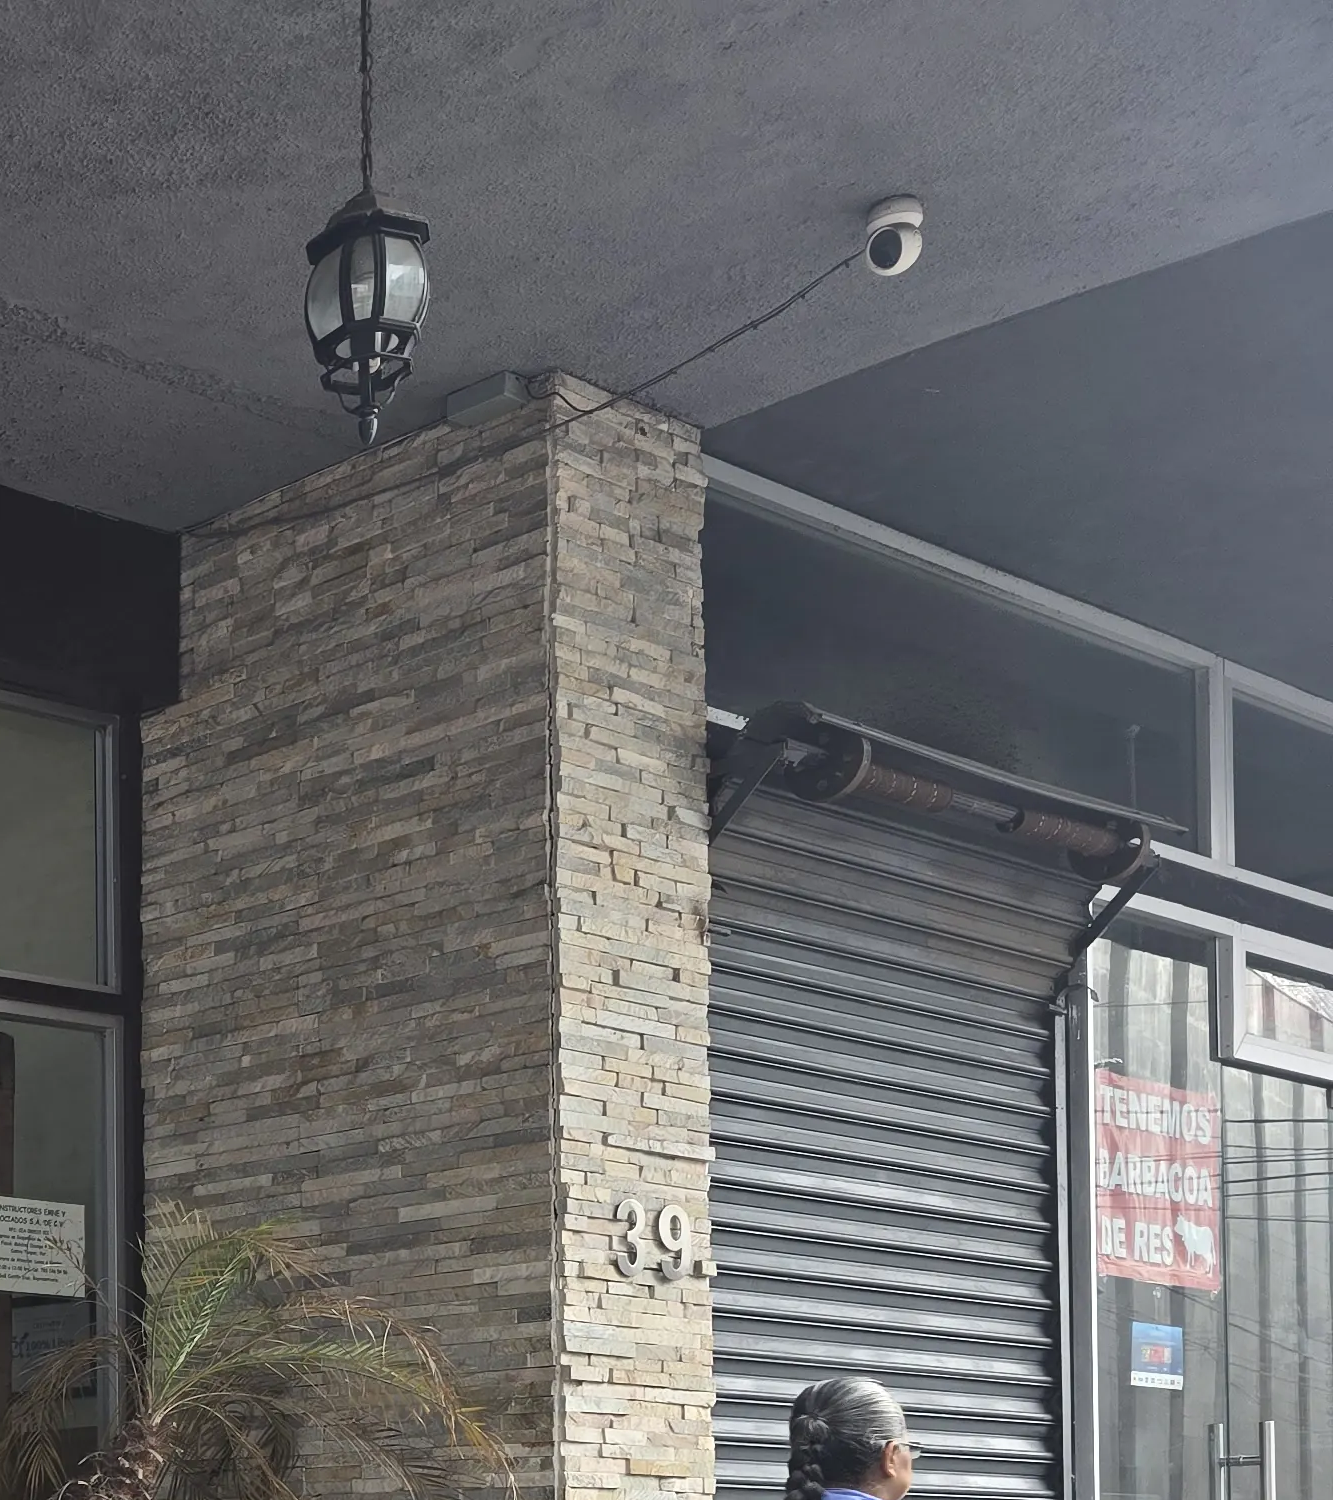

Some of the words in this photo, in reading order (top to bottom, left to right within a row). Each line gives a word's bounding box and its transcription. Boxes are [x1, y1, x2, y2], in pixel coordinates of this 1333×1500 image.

[1099, 1084, 1213, 1145] TENEMOS
[1098, 1148, 1213, 1208] BARBACOA
[616, 1198, 692, 1282] 39
[1101, 1215, 1127, 1259] DE
[1134, 1221, 1175, 1266] RES
